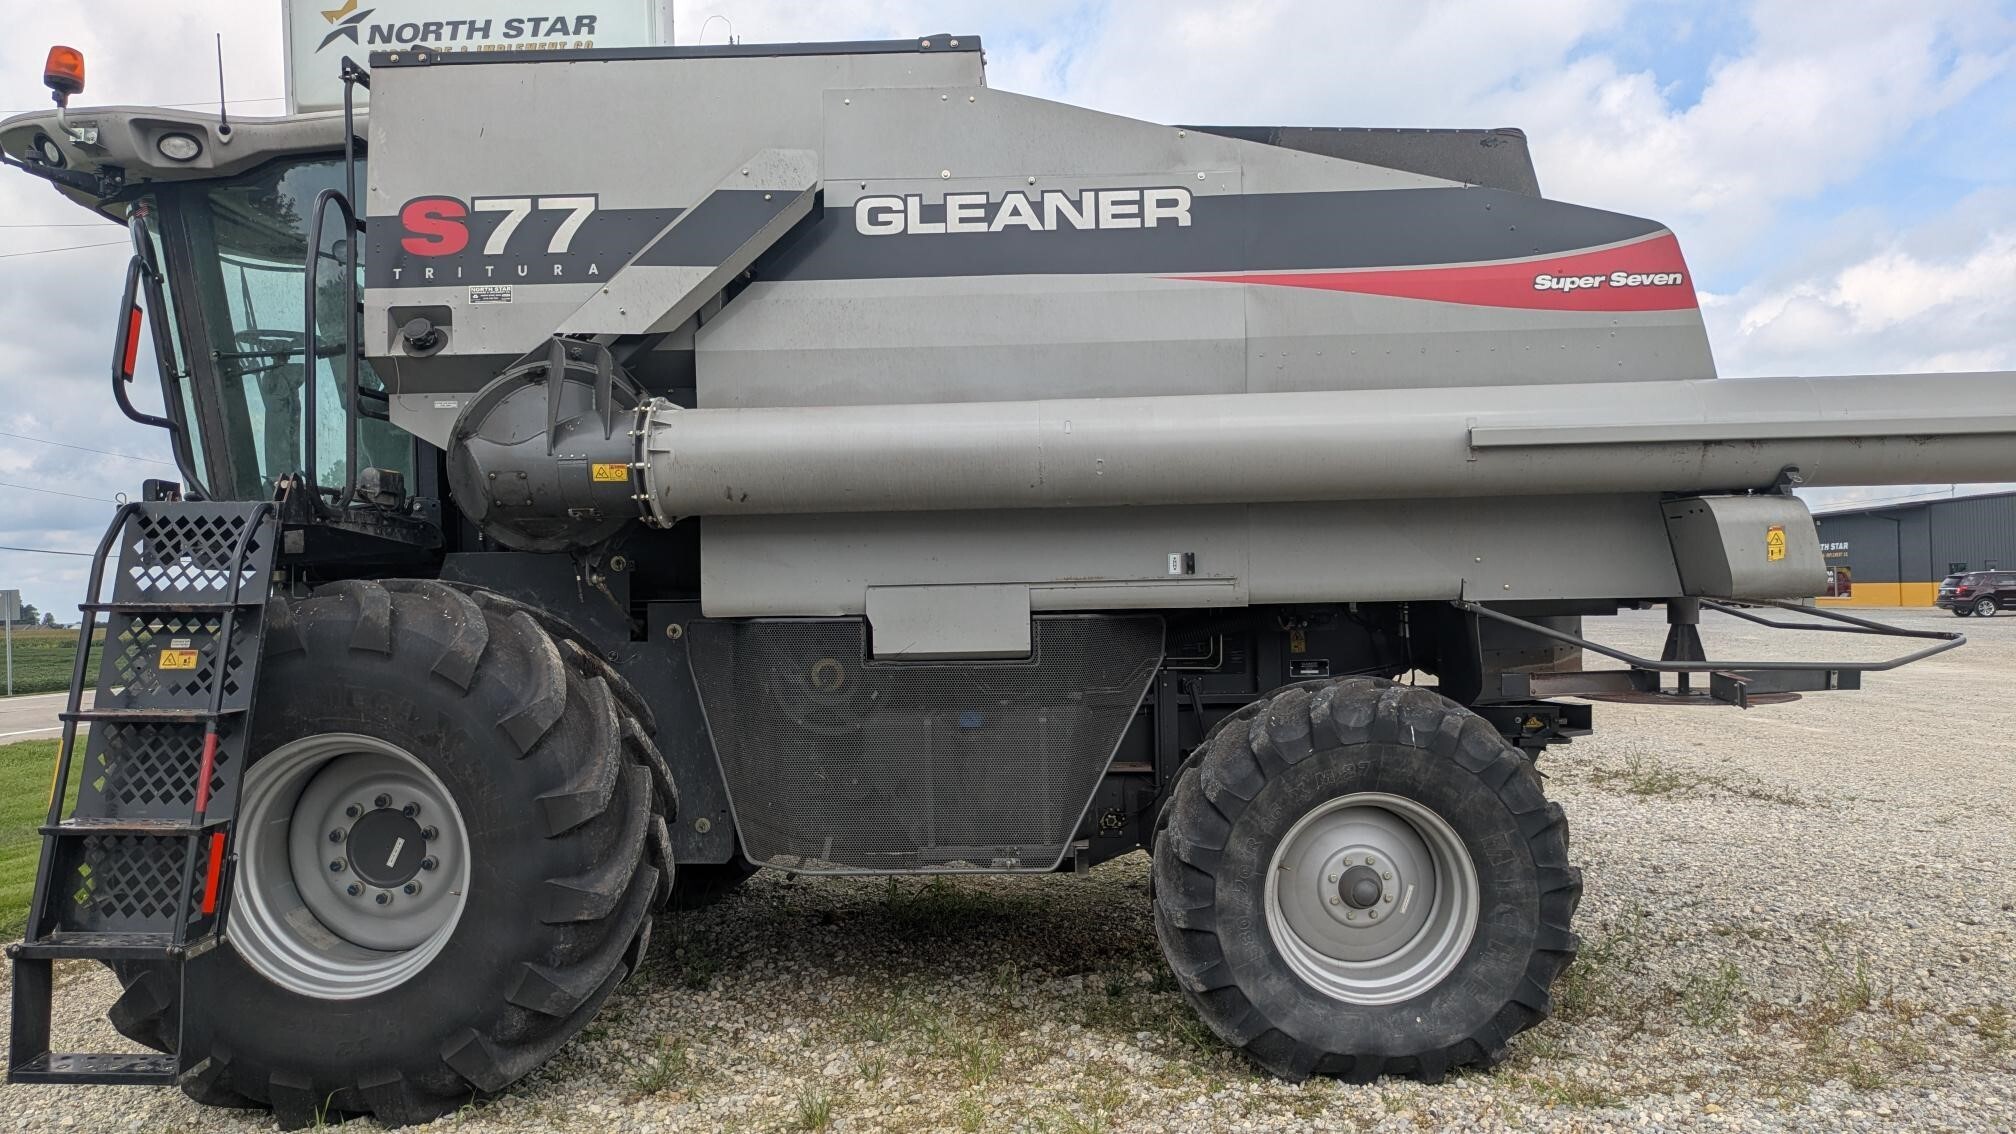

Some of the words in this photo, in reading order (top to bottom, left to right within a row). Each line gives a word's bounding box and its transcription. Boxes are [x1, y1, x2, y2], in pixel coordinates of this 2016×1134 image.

[367, 19, 493, 45] NORTH
[502, 15, 598, 39] STAR
[855, 186, 1193, 236] GLEANER
[401, 196, 597, 257] S77
[393, 262, 599, 280] TRITURA
[1534, 274, 1606, 292] Super
[1609, 271, 1683, 288] Seven
[1830, 542, 1849, 550] STAR
